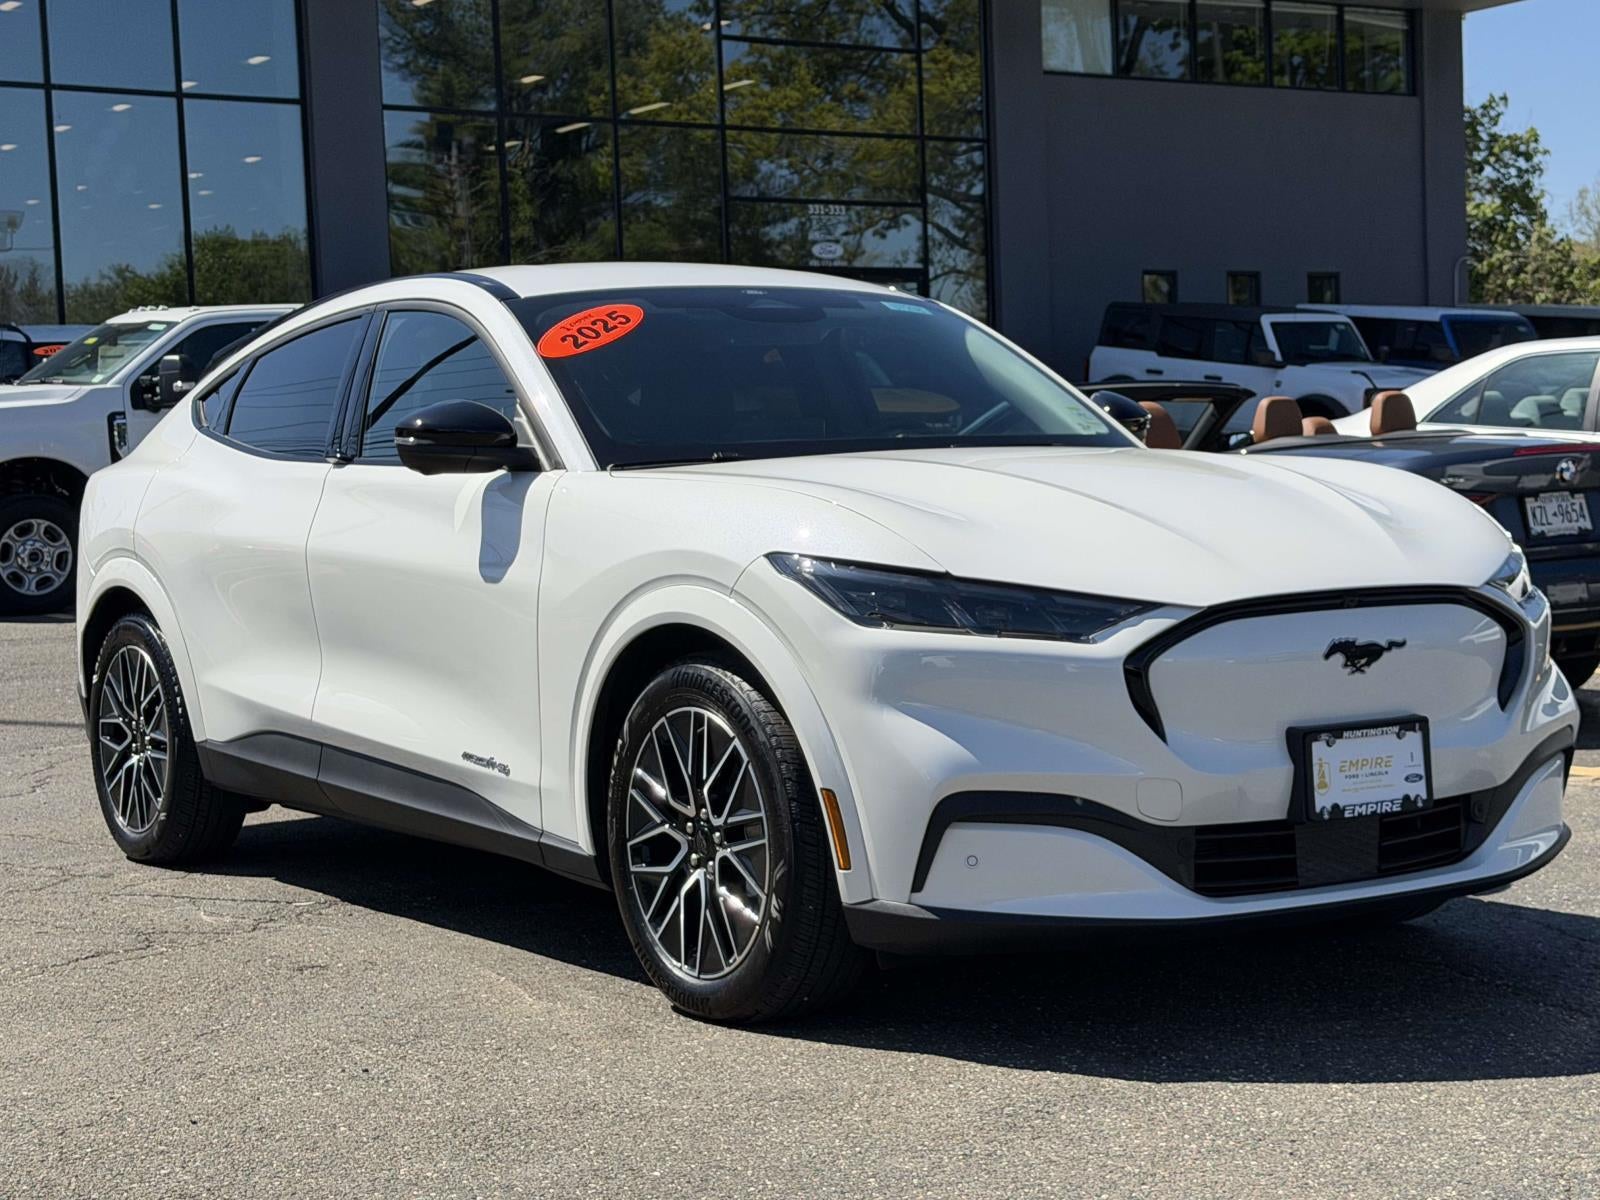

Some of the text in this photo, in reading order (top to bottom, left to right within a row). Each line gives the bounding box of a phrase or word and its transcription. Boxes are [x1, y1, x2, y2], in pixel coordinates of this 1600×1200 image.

[560, 310, 632, 350] 2025
[1342, 725, 1400, 739] HUNTINGTON
[1338, 755, 1394, 773] EMPIRE
[1365, 770, 1389, 778] LINCOLN
[1343, 799, 1403, 818] EMPIRE
